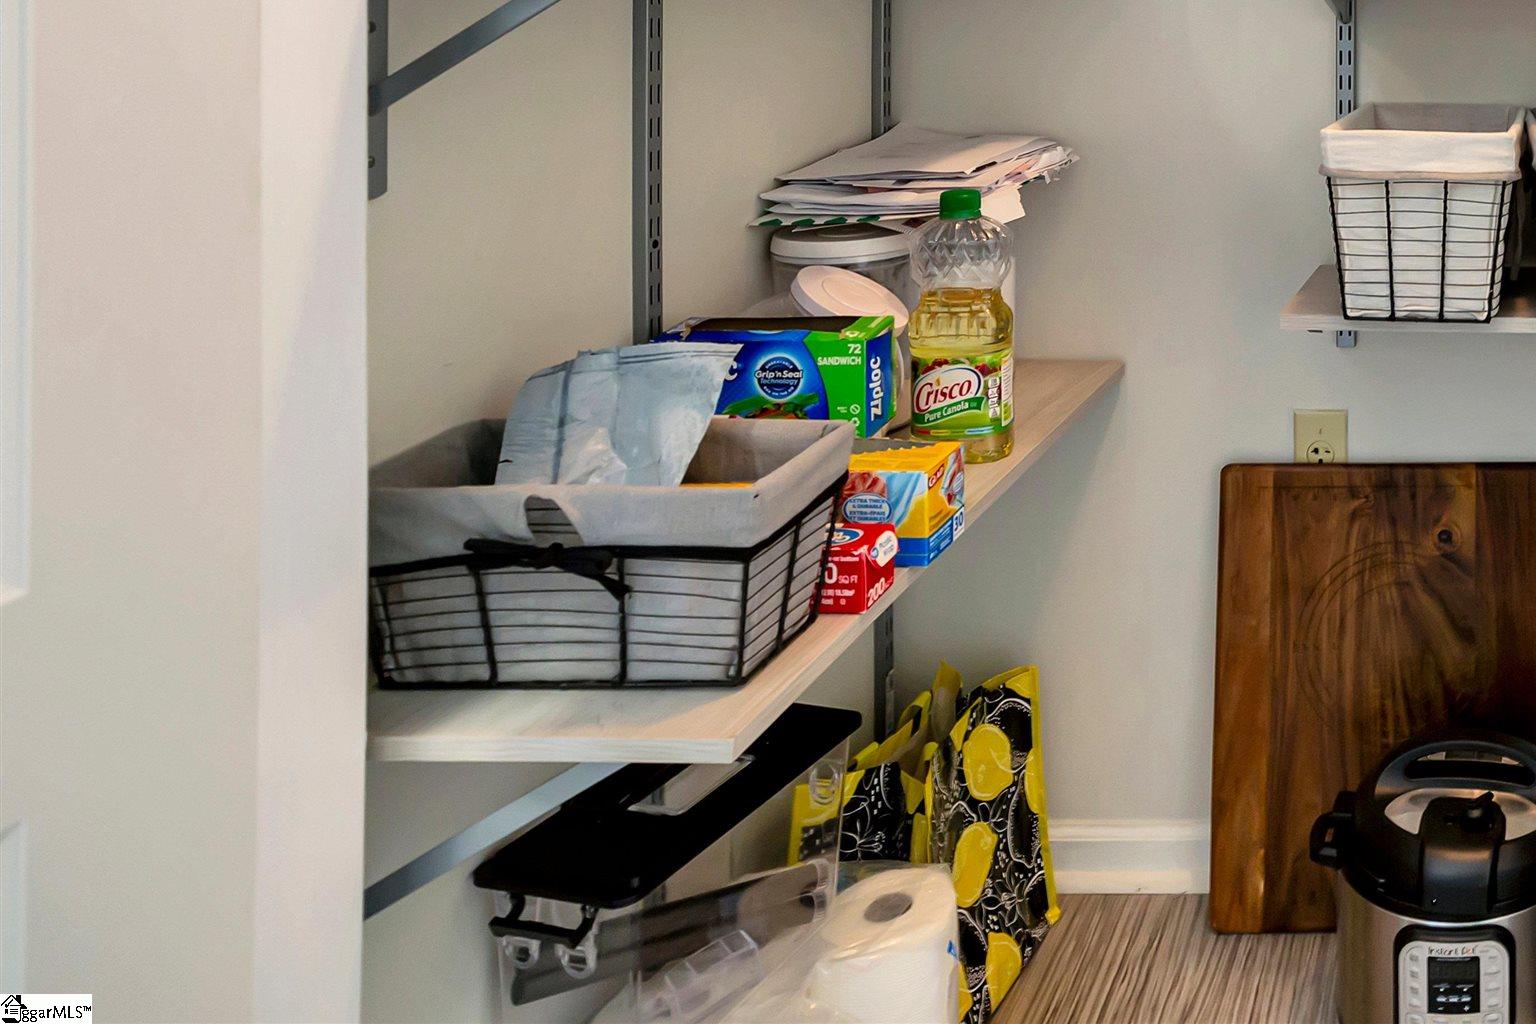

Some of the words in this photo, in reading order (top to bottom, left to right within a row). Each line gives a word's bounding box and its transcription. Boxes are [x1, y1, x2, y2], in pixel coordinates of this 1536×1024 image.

[847, 343, 862, 354] 72
[816, 356, 862, 366] SANDWICH
[782, 369, 804, 378] Seal
[760, 378, 798, 386] Technology
[869, 356, 884, 421] Ziploc
[915, 379, 972, 414] Crisco
[924, 410, 941, 423] Pure
[942, 401, 969, 417] Canola
[954, 512, 964, 532] 30
[838, 575, 849, 584] SQ
[850, 575, 858, 583] FT
[867, 577, 886, 608] 200
[1428, 946, 1459, 956] Instant
